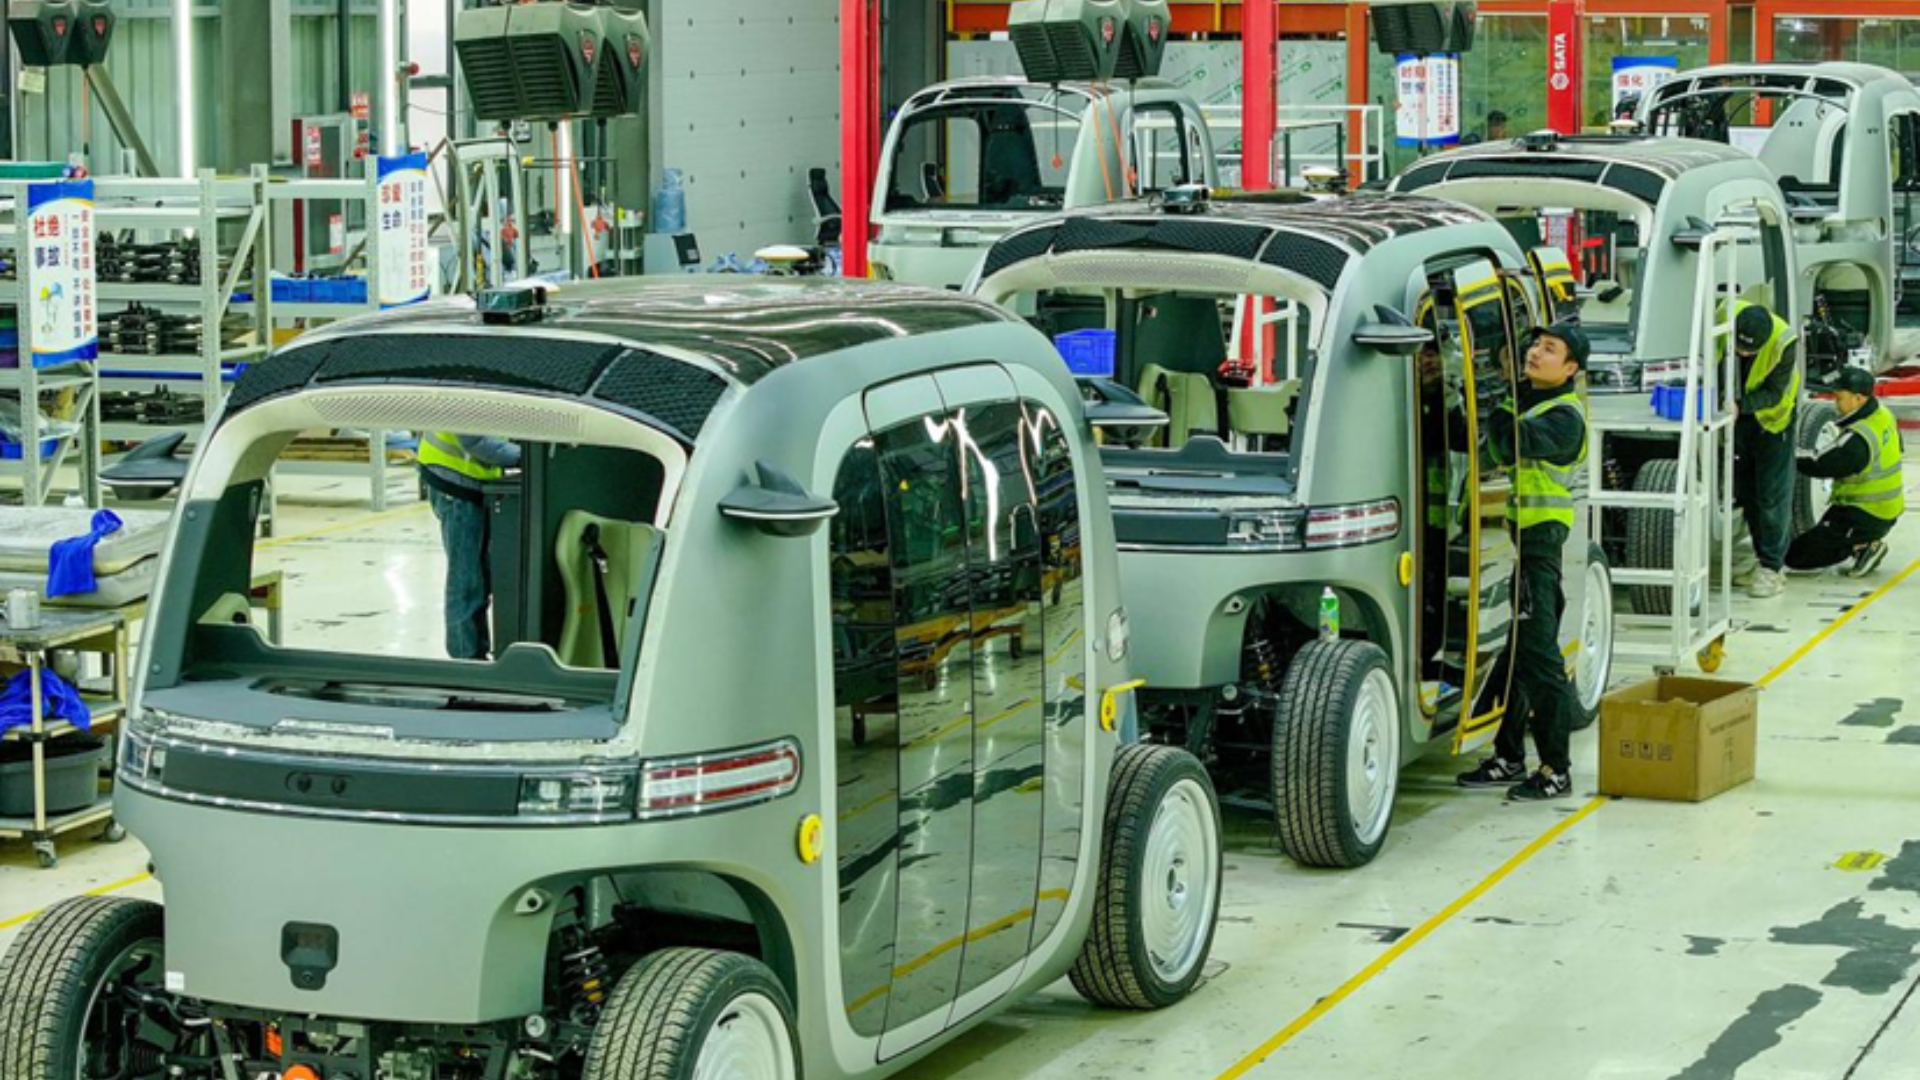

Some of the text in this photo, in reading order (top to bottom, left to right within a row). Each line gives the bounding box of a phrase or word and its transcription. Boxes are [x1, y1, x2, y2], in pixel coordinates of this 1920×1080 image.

[1554, 33, 1566, 70] SATA
[1617, 74, 1644, 88] 强化
[34, 215, 60, 239] 杜绝
[382, 210, 401, 231] 生命
[34, 246, 61, 269] 事故
